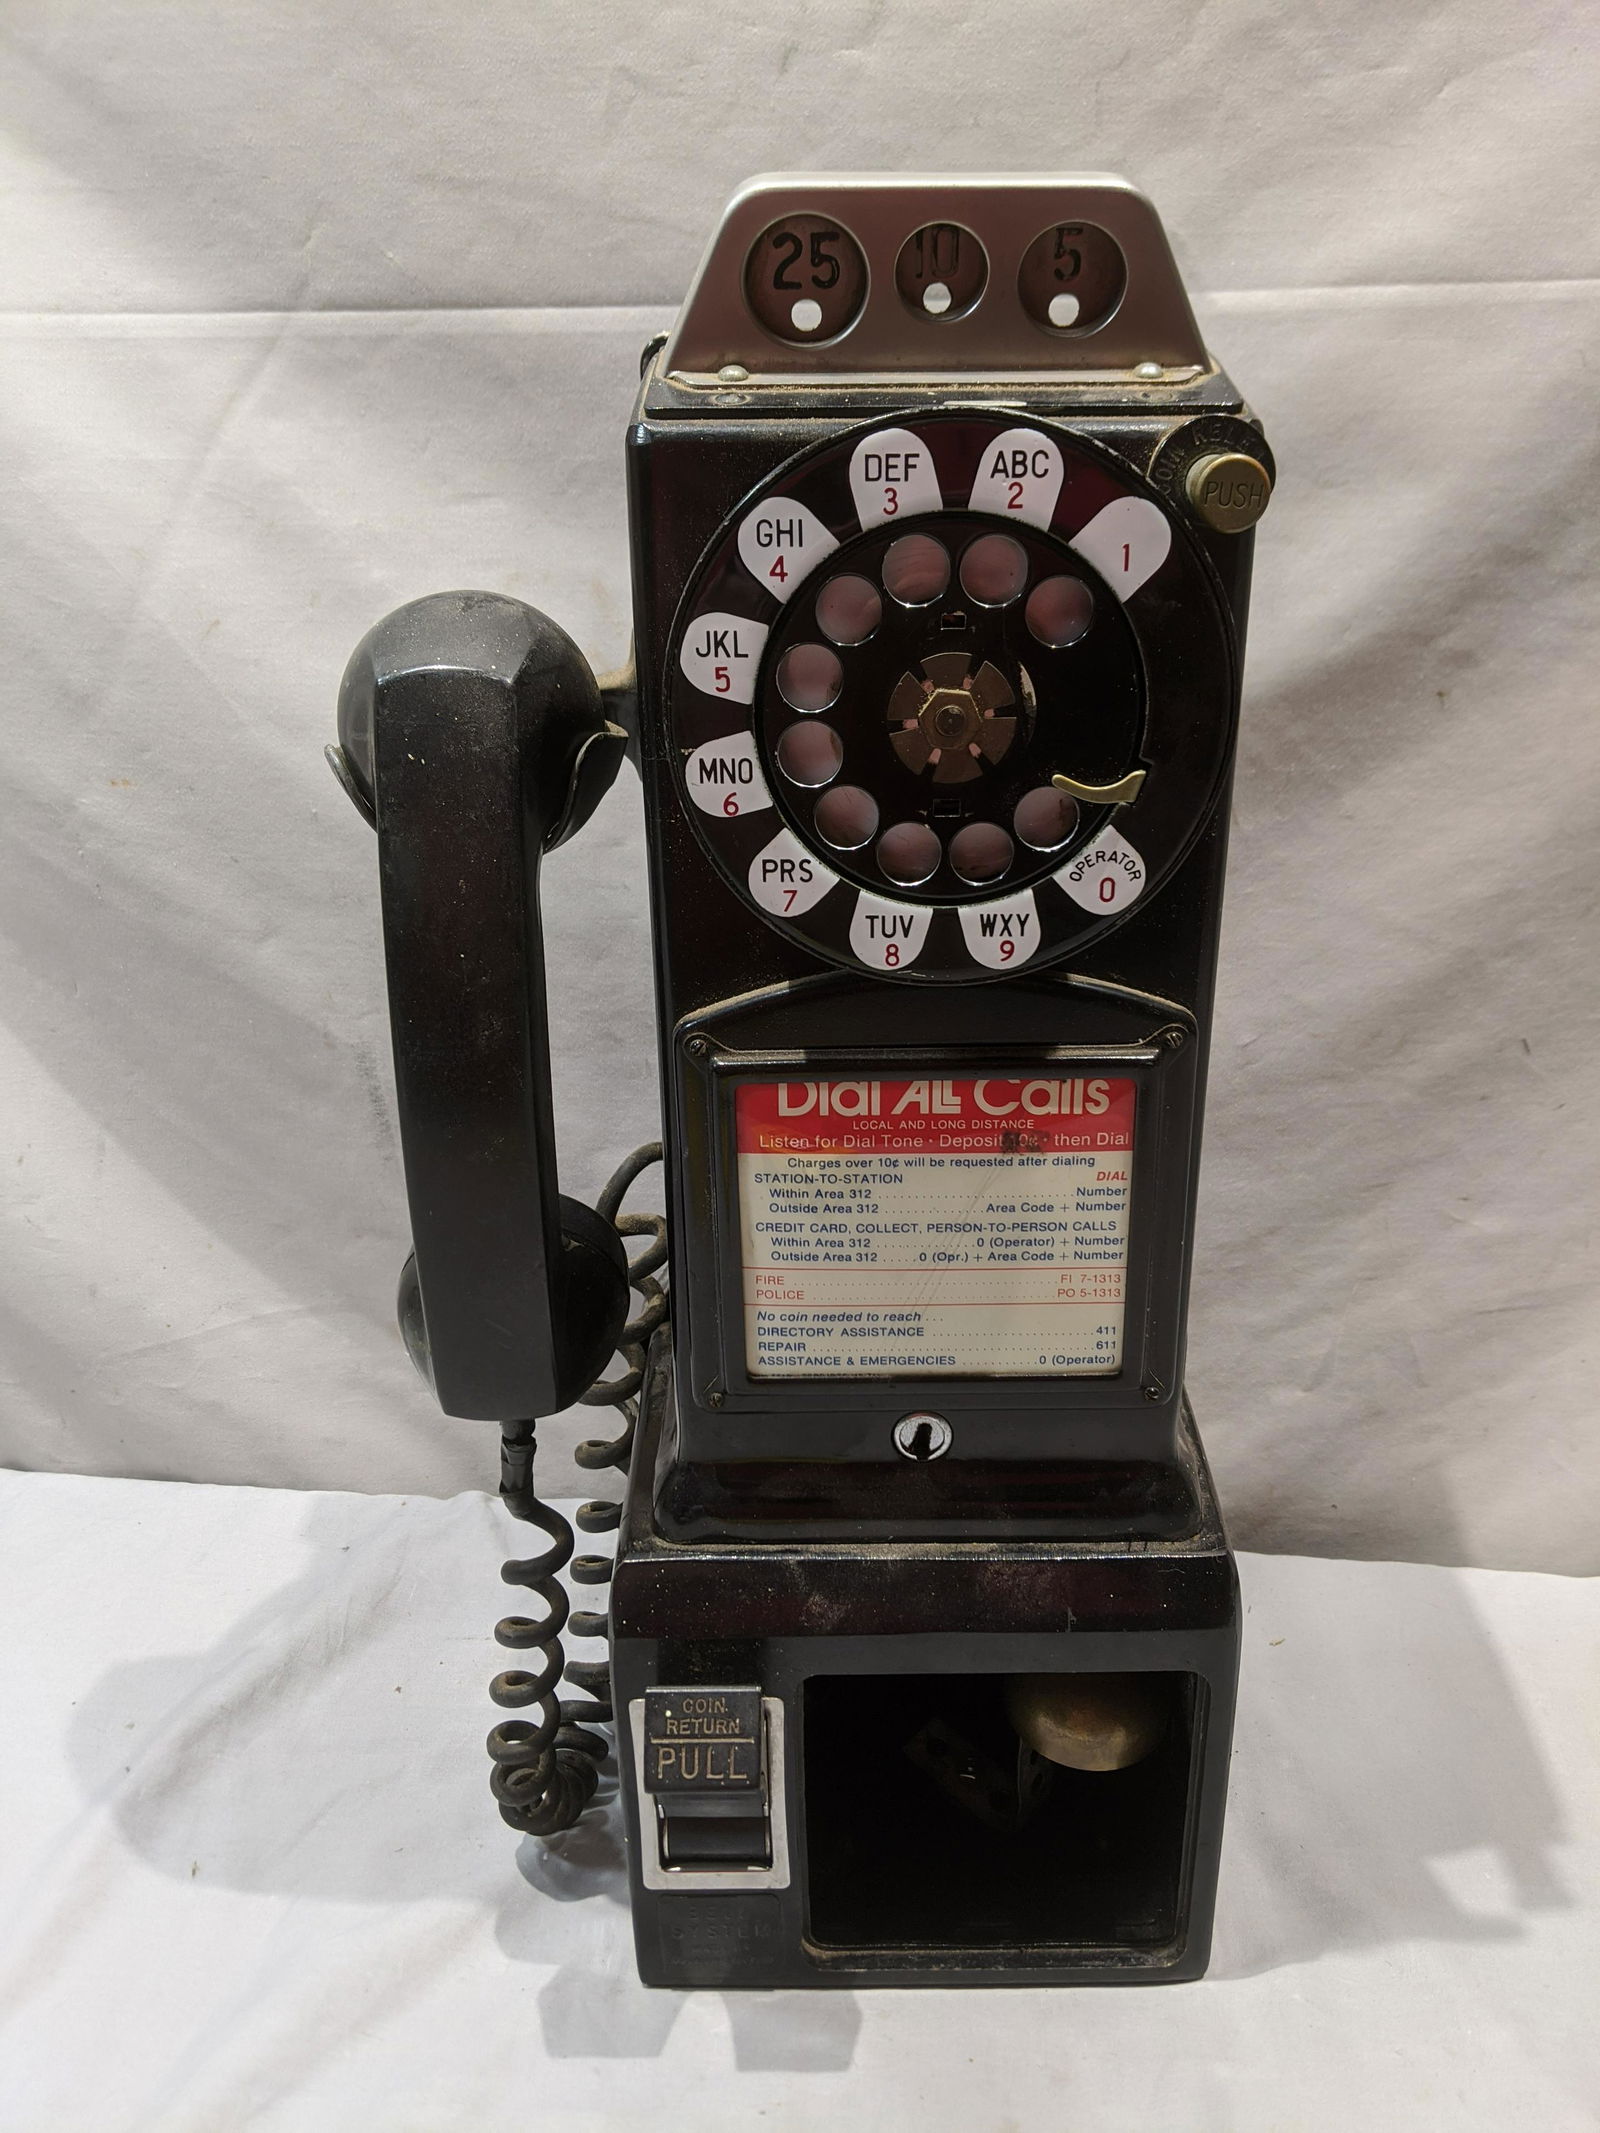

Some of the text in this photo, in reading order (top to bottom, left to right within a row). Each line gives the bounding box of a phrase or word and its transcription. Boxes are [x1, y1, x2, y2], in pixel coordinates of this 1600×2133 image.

[772, 231, 841, 289] 25
[1053, 227, 1082, 282] 5
[864, 453, 921, 482] DEF
[990, 449, 1051, 479] ABC
[882, 487, 899, 516] 3
[1007, 482, 1025, 509] 2
[1203, 480, 1265, 508] PUSH
[755, 518, 803, 549] GHI
[1121, 543, 1131, 571] 1
[768, 556, 789, 583] 4
[696, 631, 748, 659] JKL
[714, 667, 731, 693] 5
[699, 758, 753, 784] MNO
[722, 792, 740, 817] 6
[761, 859, 813, 883] PRS
[1070, 850, 1142, 883] OPERATOR
[782, 889, 798, 912] 7
[1100, 877, 1115, 902] 0
[865, 915, 914, 939] TUV
[979, 913, 1030, 937] WXY
[885, 944, 900, 966] 8
[999, 940, 1015, 961] 9
[778, 1079, 1110, 1117] Dial ALL Calls
[853, 1120, 1034, 1130] LOCAL AND LONG DISTANCE
[760, 1135, 810, 1148] Listen
[814, 1135, 838, 1148] for
[844, 1135, 875, 1148] Dial
[882, 1135, 923, 1148] Tone
[1054, 1133, 1093, 1146] then
[1097, 1133, 1129, 1145] Dial
[787, 1156, 1095, 1169] Charges over 10¢ will be requested after dialing
[755, 1174, 903, 1184] STATION-TO-STATION
[1096, 1172, 1128, 1181] DIAL
[770, 1187, 1127, 1199] Within Area 312 Number
[770, 1203, 819, 1214] Outside
[823, 1204, 852, 1213] Area
[856, 1203, 878, 1213] 312
[986, 1203, 1016, 1213] Area
[1020, 1202, 1055, 1213] Code
[1075, 1202, 1126, 1211] Number
[755, 1221, 1117, 1235] CREDIT CARD, COLLECT, PERSON-TO-PERSON CALLS
[771, 1237, 810, 1248] Within
[815, 1238, 844, 1248] Area
[849, 1237, 871, 1248] 312
[977, 1238, 984, 1247] 0
[990, 1236, 1055, 1249] (Operator)
[1075, 1236, 1125, 1246] Number
[771, 1251, 818, 1262] Outside
[823, 1252, 852, 1262] Area
[856, 1252, 877, 1262] 312
[919, 1252, 927, 1262] 0
[932, 1251, 969, 1264] (Opr.)
[987, 1252, 1017, 1261] Area
[1021, 1251, 1055, 1261] Code
[1074, 1250, 1124, 1260] Number
[756, 1274, 1122, 1285] FIRE FI 7-1313
[756, 1288, 1121, 1300] POLICE PO 5-1313
[757, 1311, 921, 1322] No coin needed to reach
[757, 1326, 1116, 1337] DIRECTORY ASSISTANCE 411
[758, 1341, 1117, 1352] REPAIR 611
[758, 1353, 1116, 1366] ASSISTANCE & EMERGENCIES 0 (Operator)
[682, 1698, 725, 1713] COIN
[666, 1718, 740, 1735] RETURN
[657, 1746, 747, 1780] PULL
